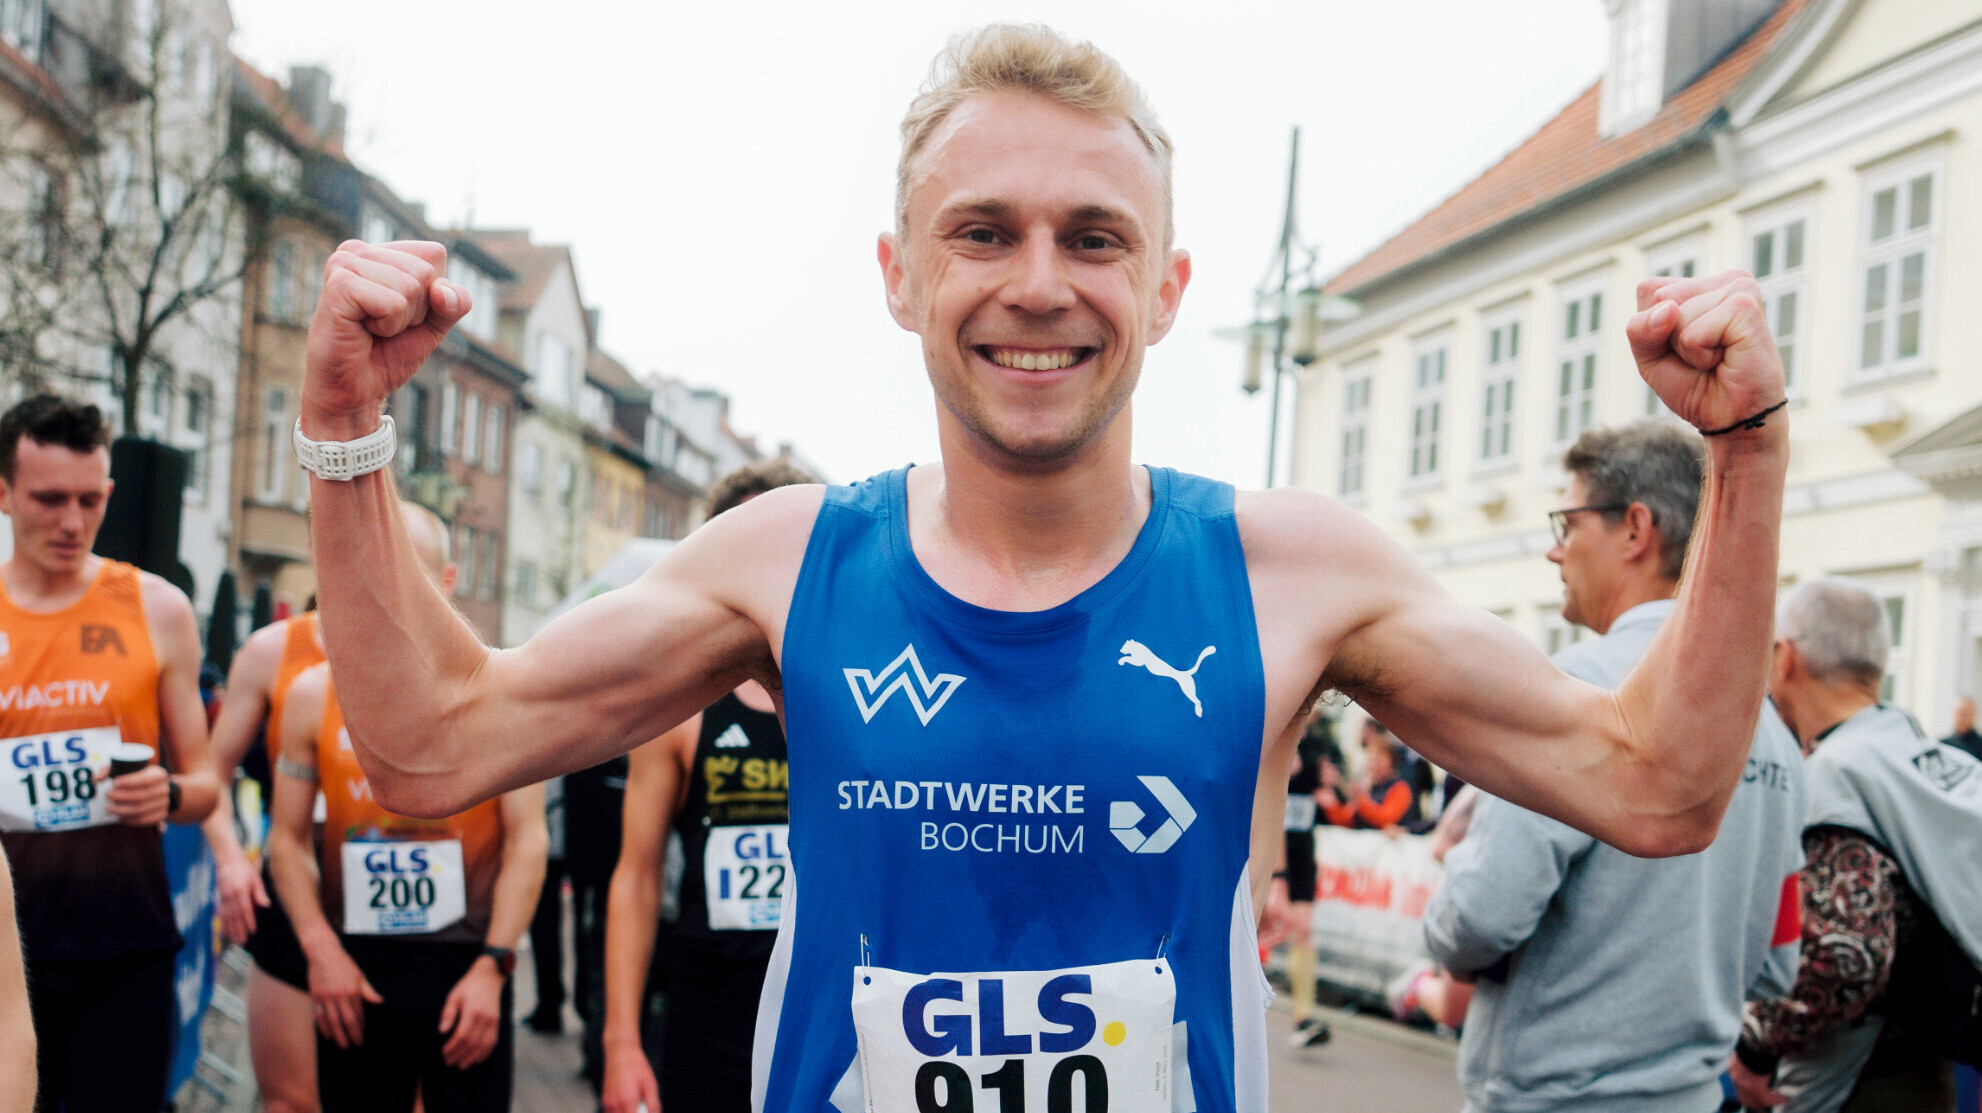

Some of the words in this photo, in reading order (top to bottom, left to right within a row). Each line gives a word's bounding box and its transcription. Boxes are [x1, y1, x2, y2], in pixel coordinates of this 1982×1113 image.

[20, 767, 97, 806] 198
[838, 779, 1085, 814] STADTWERKE
[734, 832, 787, 860] GL
[920, 822, 1085, 853] BOCHUM
[369, 877, 436, 909] 200
[739, 863, 786, 900] 22
[914, 1054, 1109, 1113] 910
